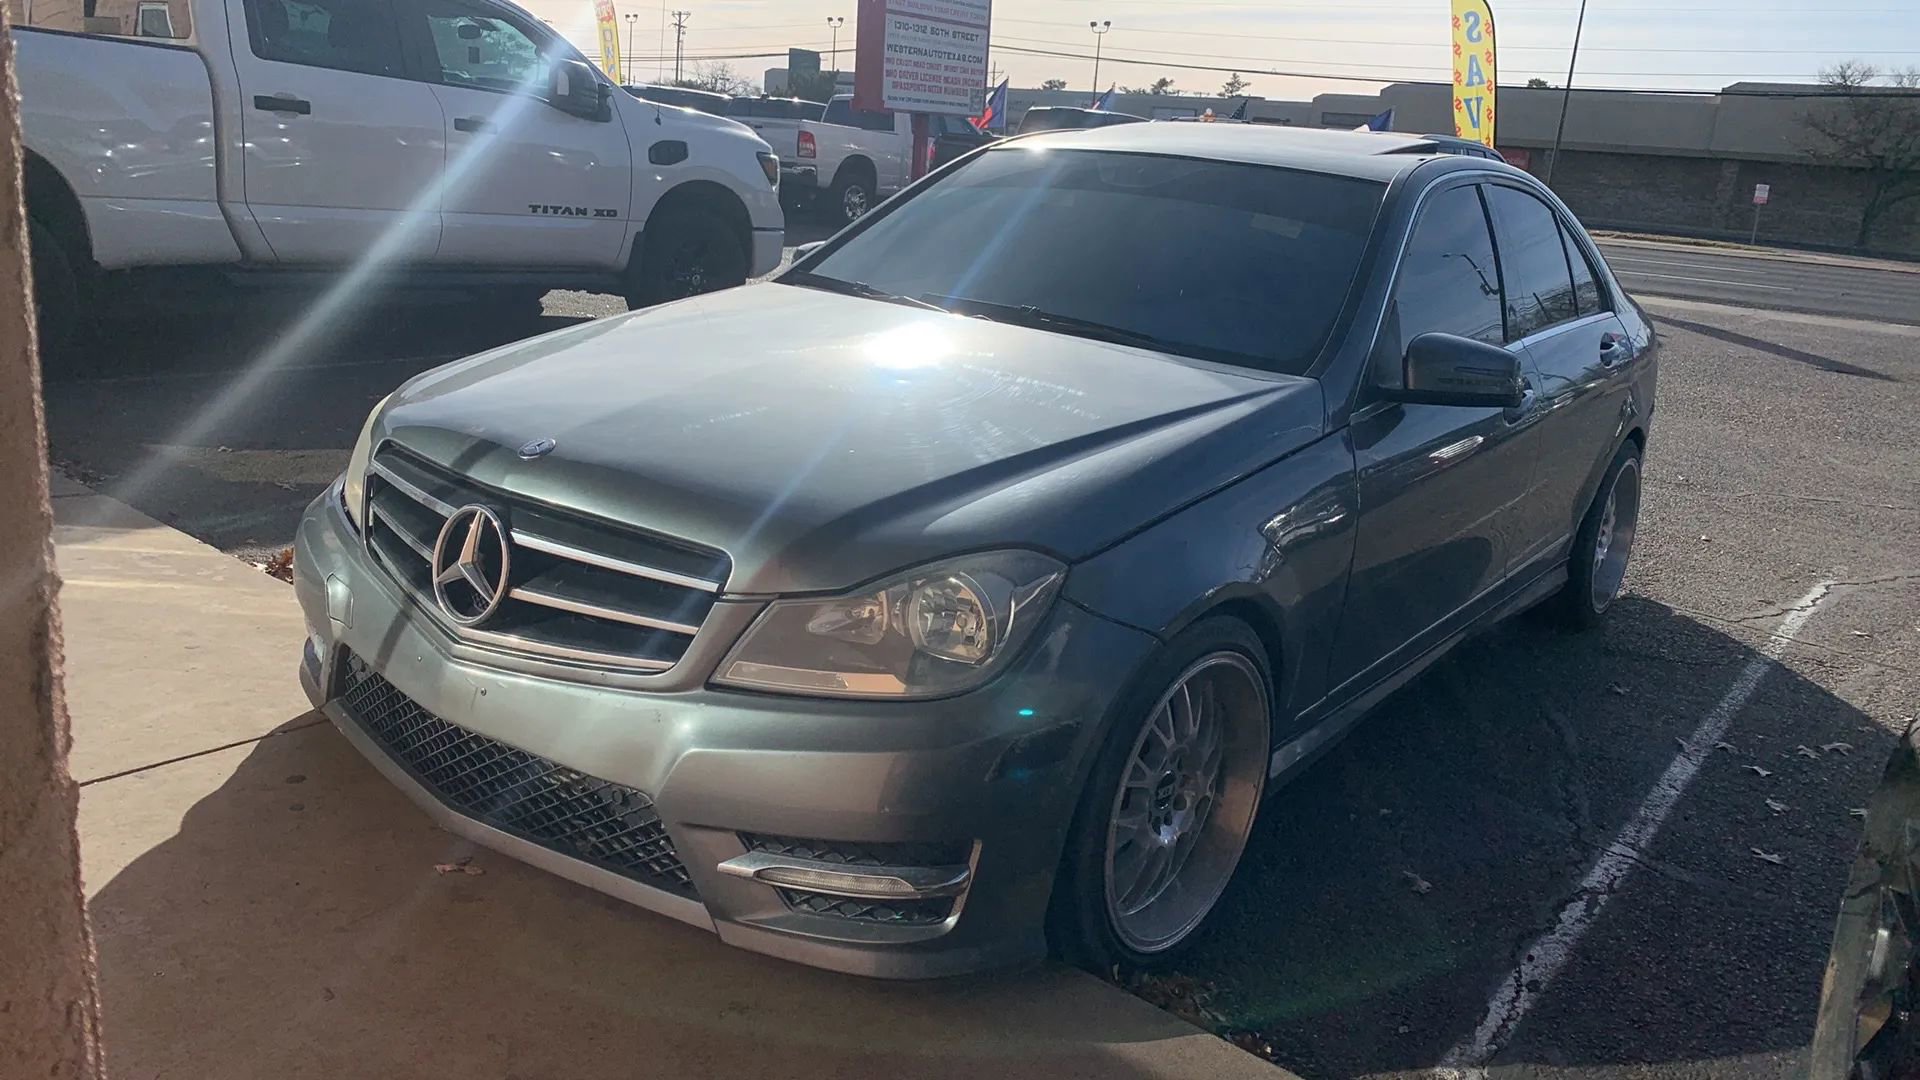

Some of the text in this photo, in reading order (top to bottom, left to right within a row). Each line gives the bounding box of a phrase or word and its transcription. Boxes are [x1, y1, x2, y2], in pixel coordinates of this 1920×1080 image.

[894, 20, 980, 42] 1310-1312 50TH STREET
[886, 43, 983, 64] WESTERNAUTOTEXAS.COM
[528, 205, 618, 218] TITAN XD
